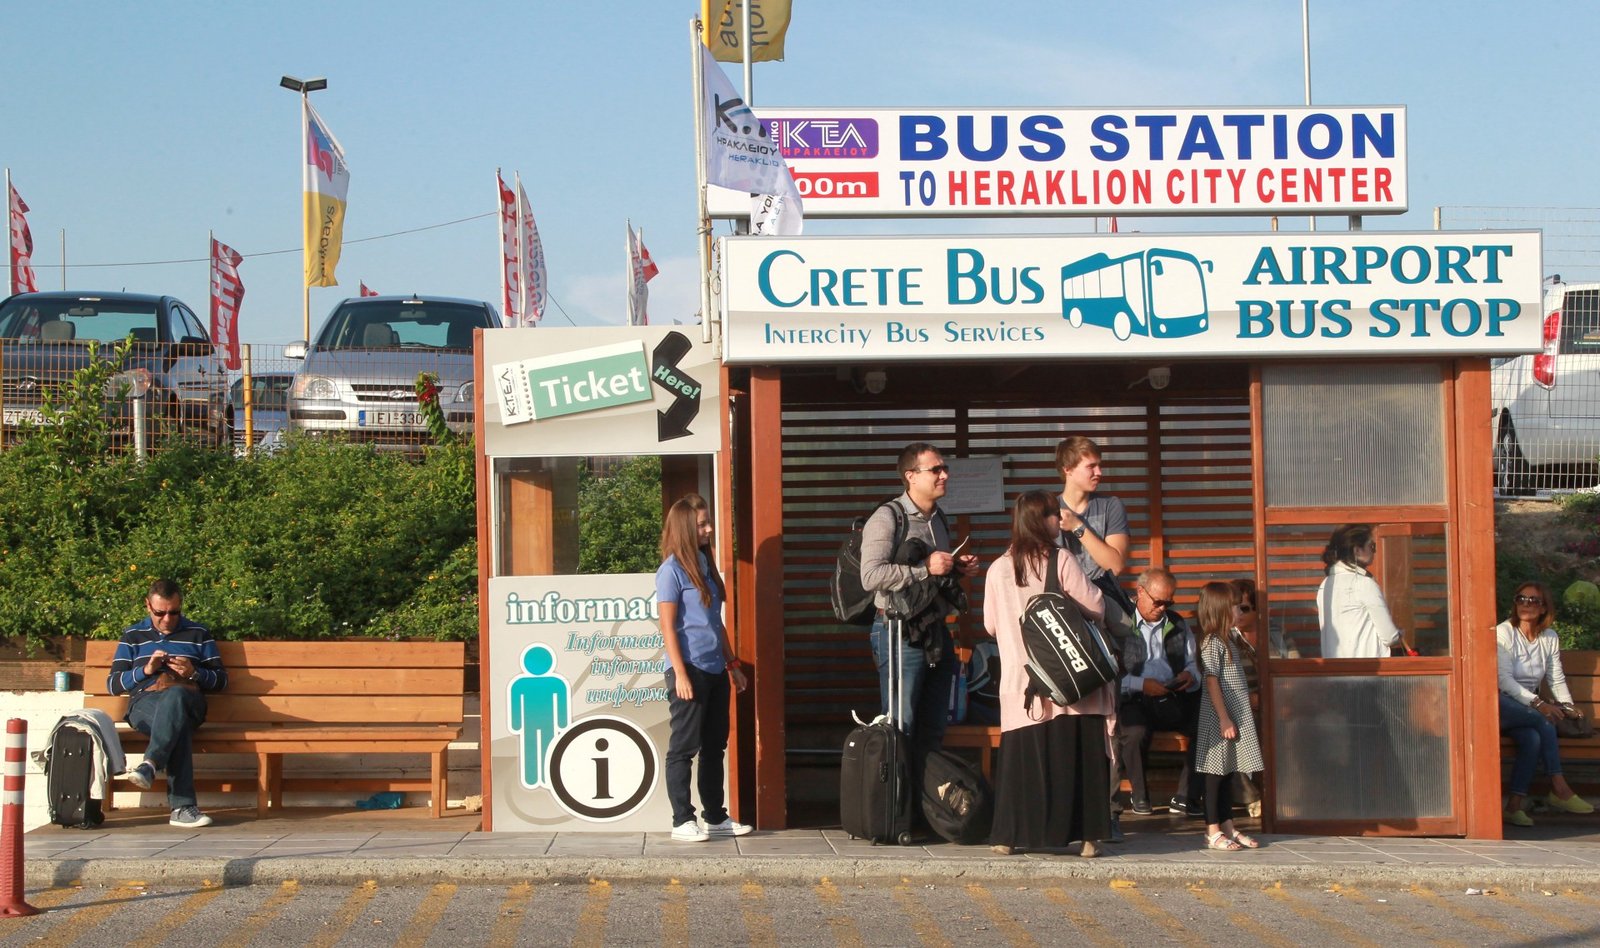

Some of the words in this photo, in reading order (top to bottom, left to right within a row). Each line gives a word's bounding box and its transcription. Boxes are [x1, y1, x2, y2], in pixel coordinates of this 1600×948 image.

[900, 114, 1066, 162] BUS
[1089, 112, 1395, 161] STATION
[899, 170, 936, 207] TO
[948, 168, 1152, 206] HERAKLION
[1166, 168, 1246, 205] CITY
[1256, 166, 1394, 204] CENTER
[1243, 244, 1514, 286] AIRPORT
[1236, 299, 1352, 340] BUS
[1368, 297, 1522, 338] STOP
[539, 365, 645, 408] Ticket
[654, 364, 702, 400] Here!
